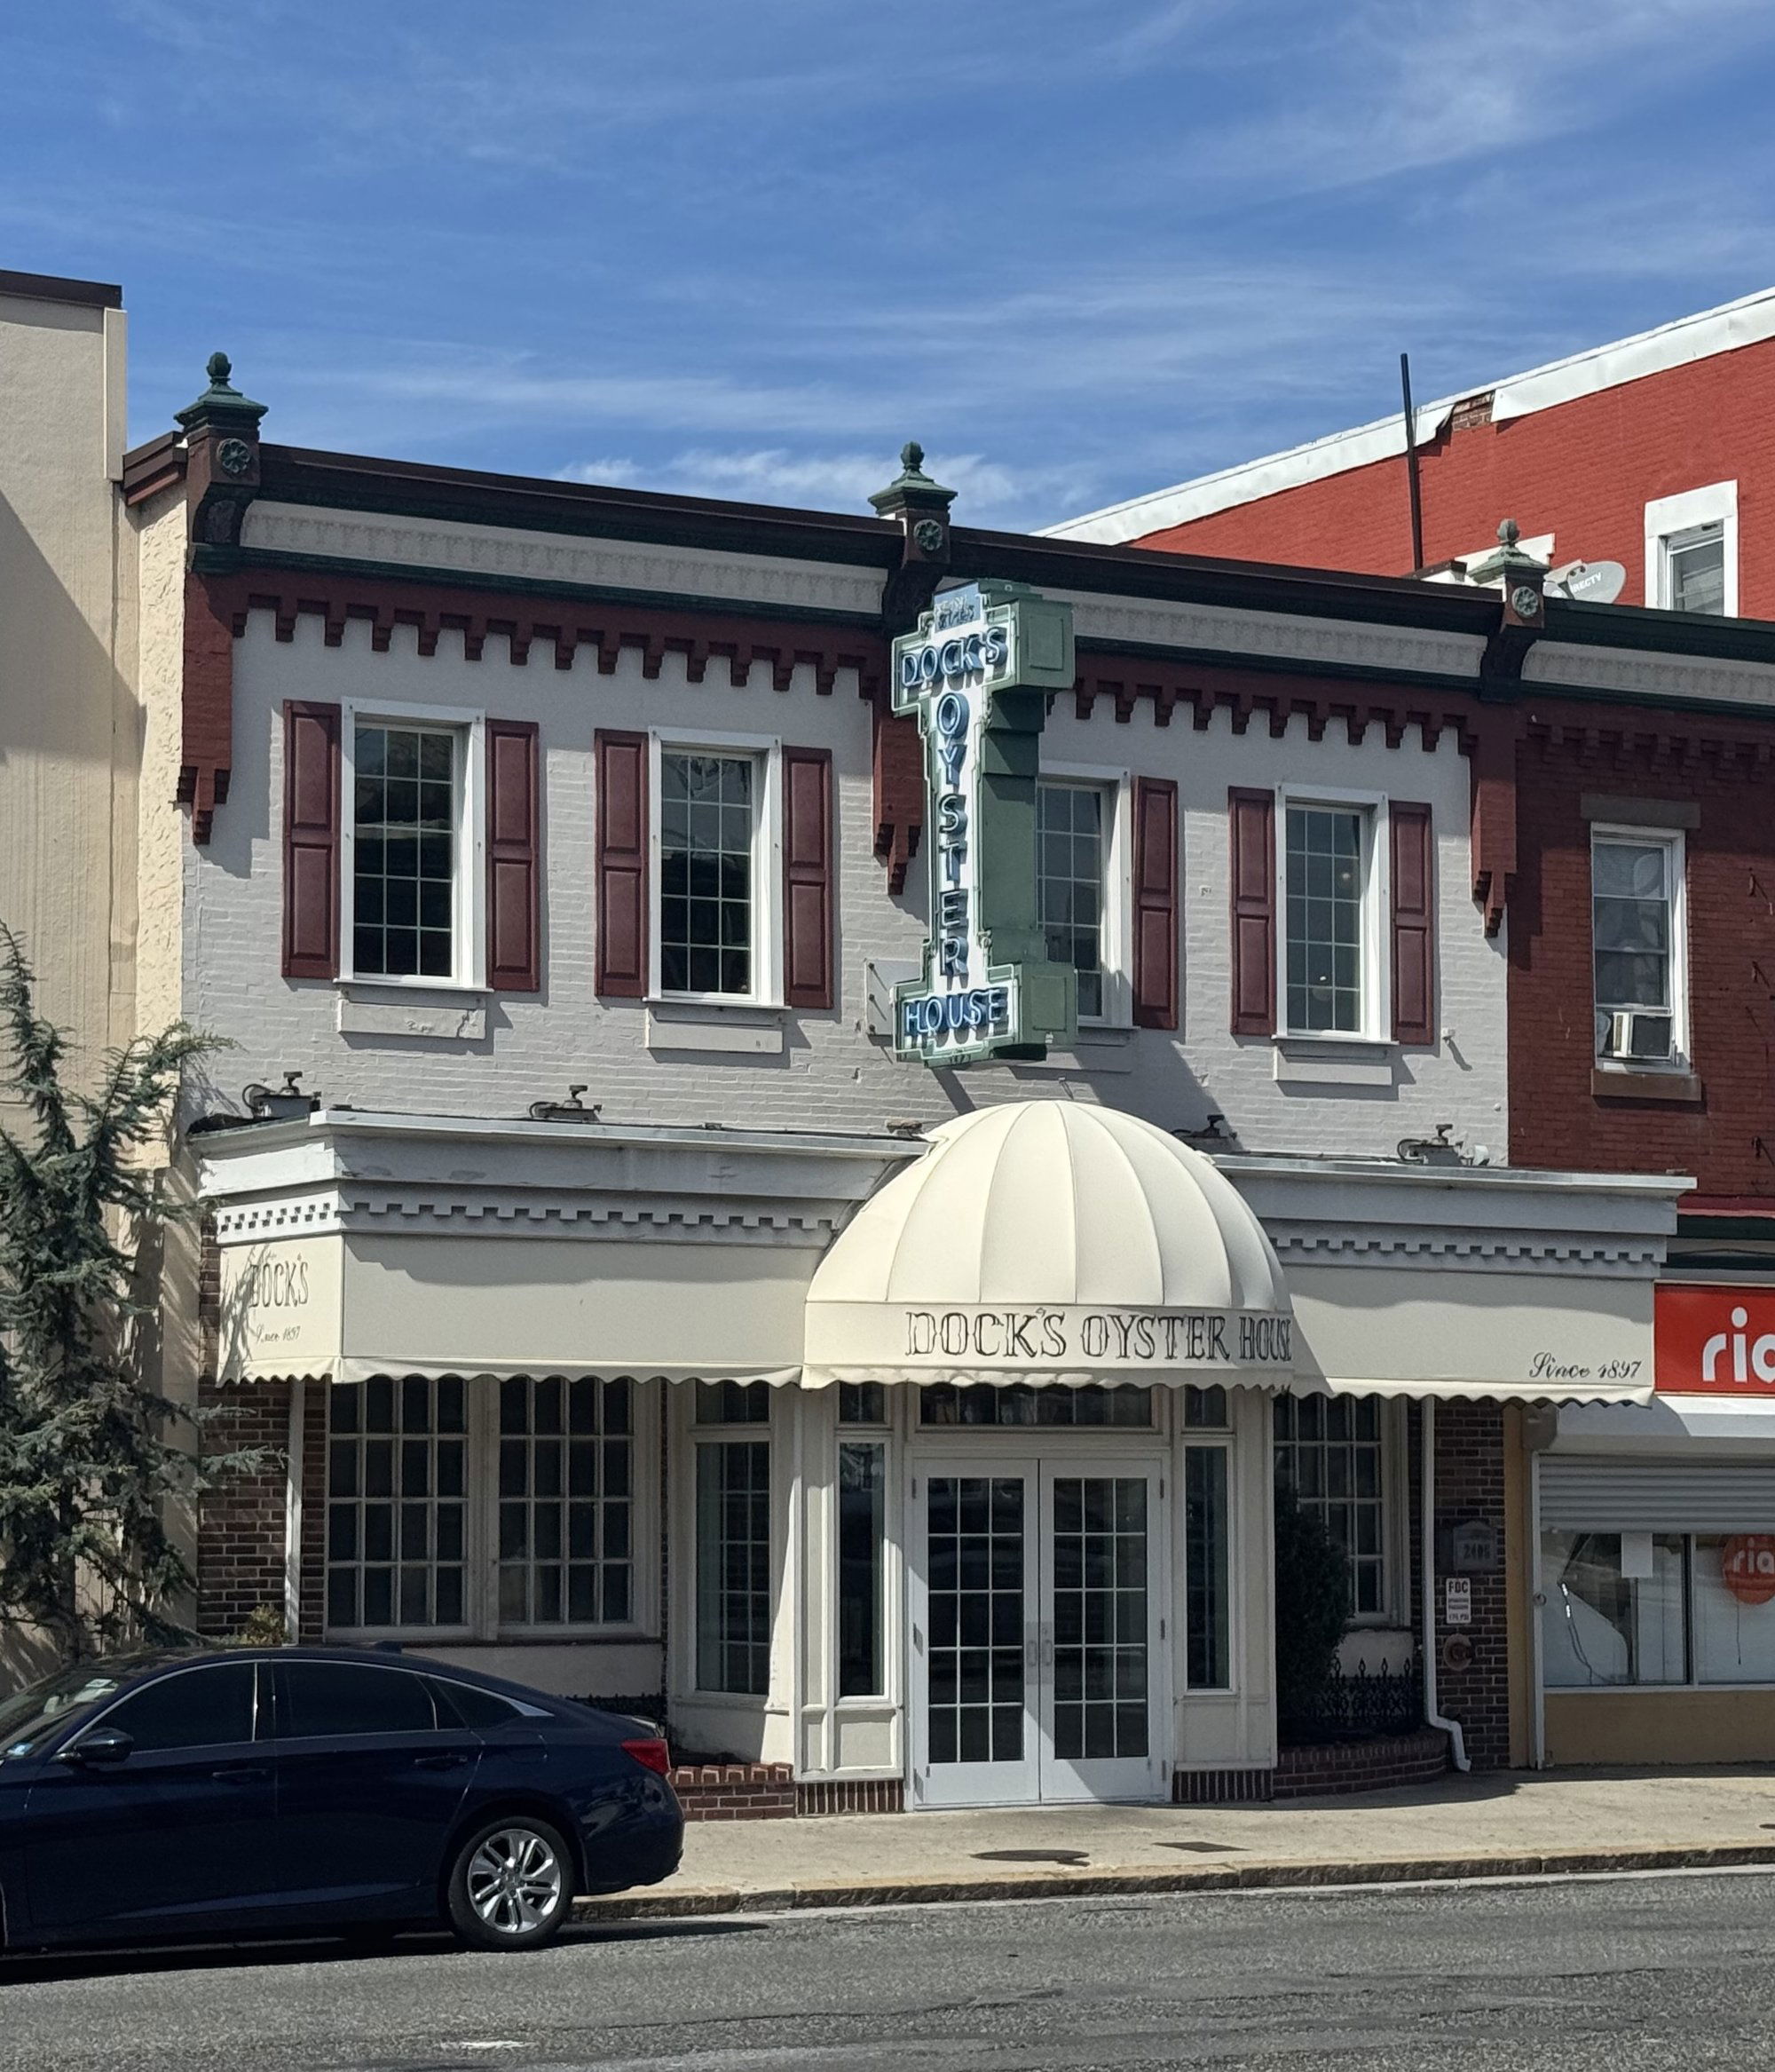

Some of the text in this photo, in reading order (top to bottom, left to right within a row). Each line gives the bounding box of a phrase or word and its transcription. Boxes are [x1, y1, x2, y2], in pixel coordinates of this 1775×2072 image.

[901, 626, 1008, 687] DOCK'S
[936, 692, 972, 977] OYSTER
[903, 987, 1009, 1037] HOUSE
[248, 1253, 309, 1309] DOCK'S
[905, 1308, 1066, 1358] DOCK'S
[1080, 1312, 1231, 1362] OYSTER
[1529, 1351, 1643, 1380] Since 1897
[1448, 1580, 1469, 1594] FDC
